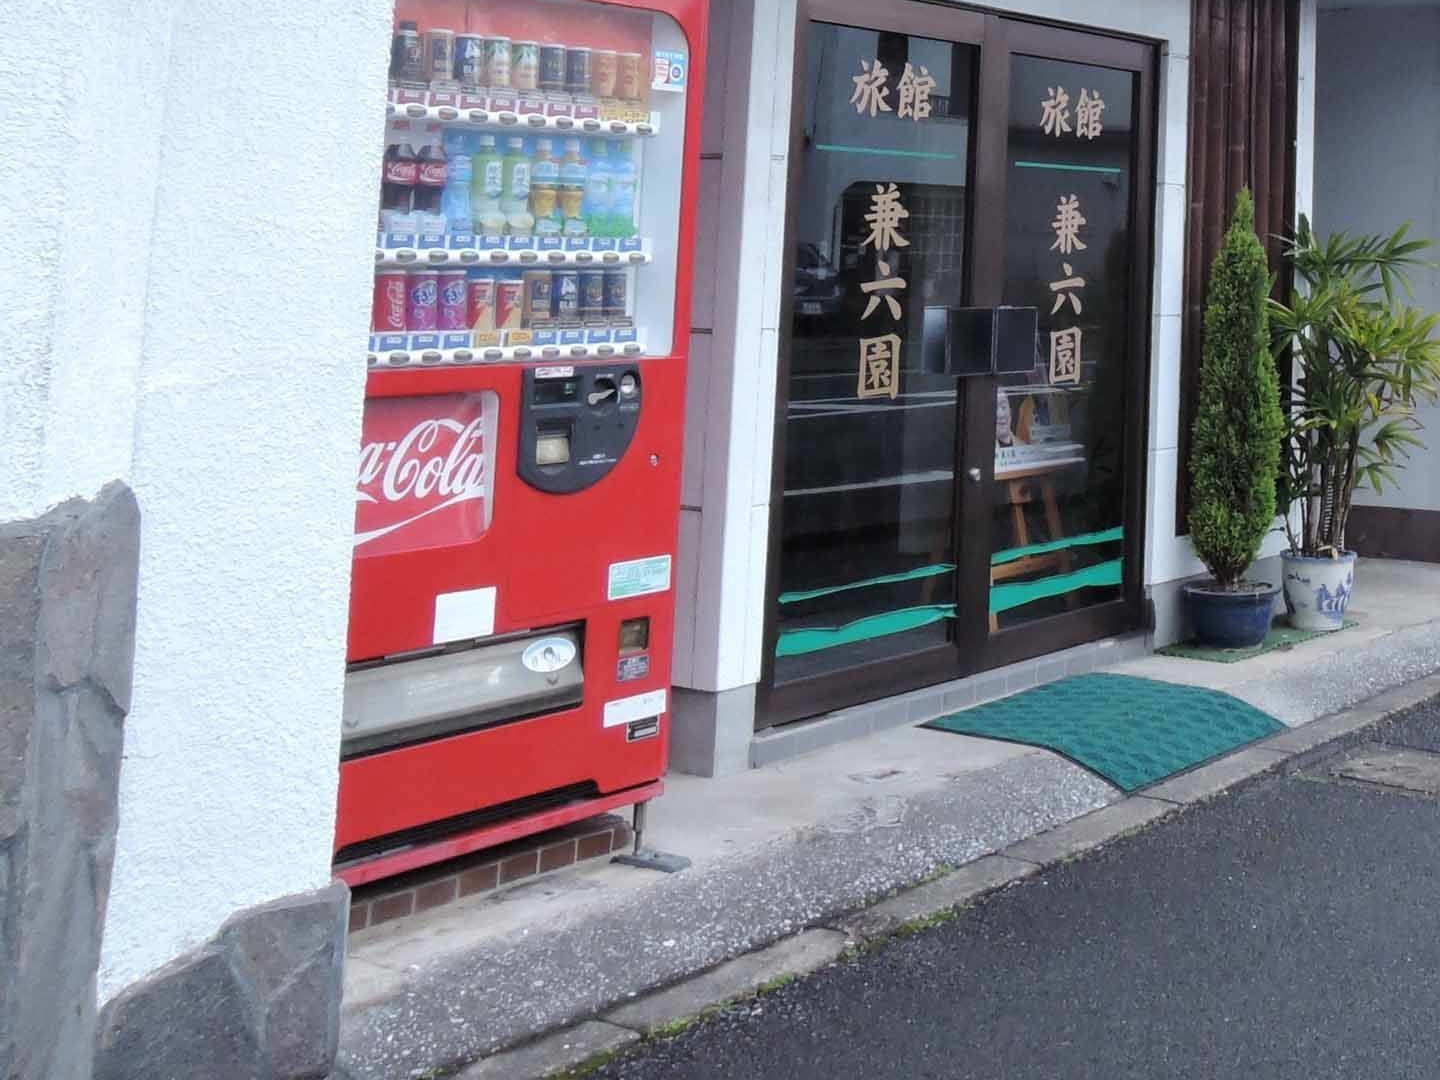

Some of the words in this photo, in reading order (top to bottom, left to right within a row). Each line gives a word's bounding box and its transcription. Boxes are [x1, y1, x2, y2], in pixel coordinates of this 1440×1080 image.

[850, 59, 937, 121] 旅館
[1040, 85, 1105, 140] 旅館
[857, 183, 911, 400] 兼六園
[1049, 194, 1087, 385] 兼六園
